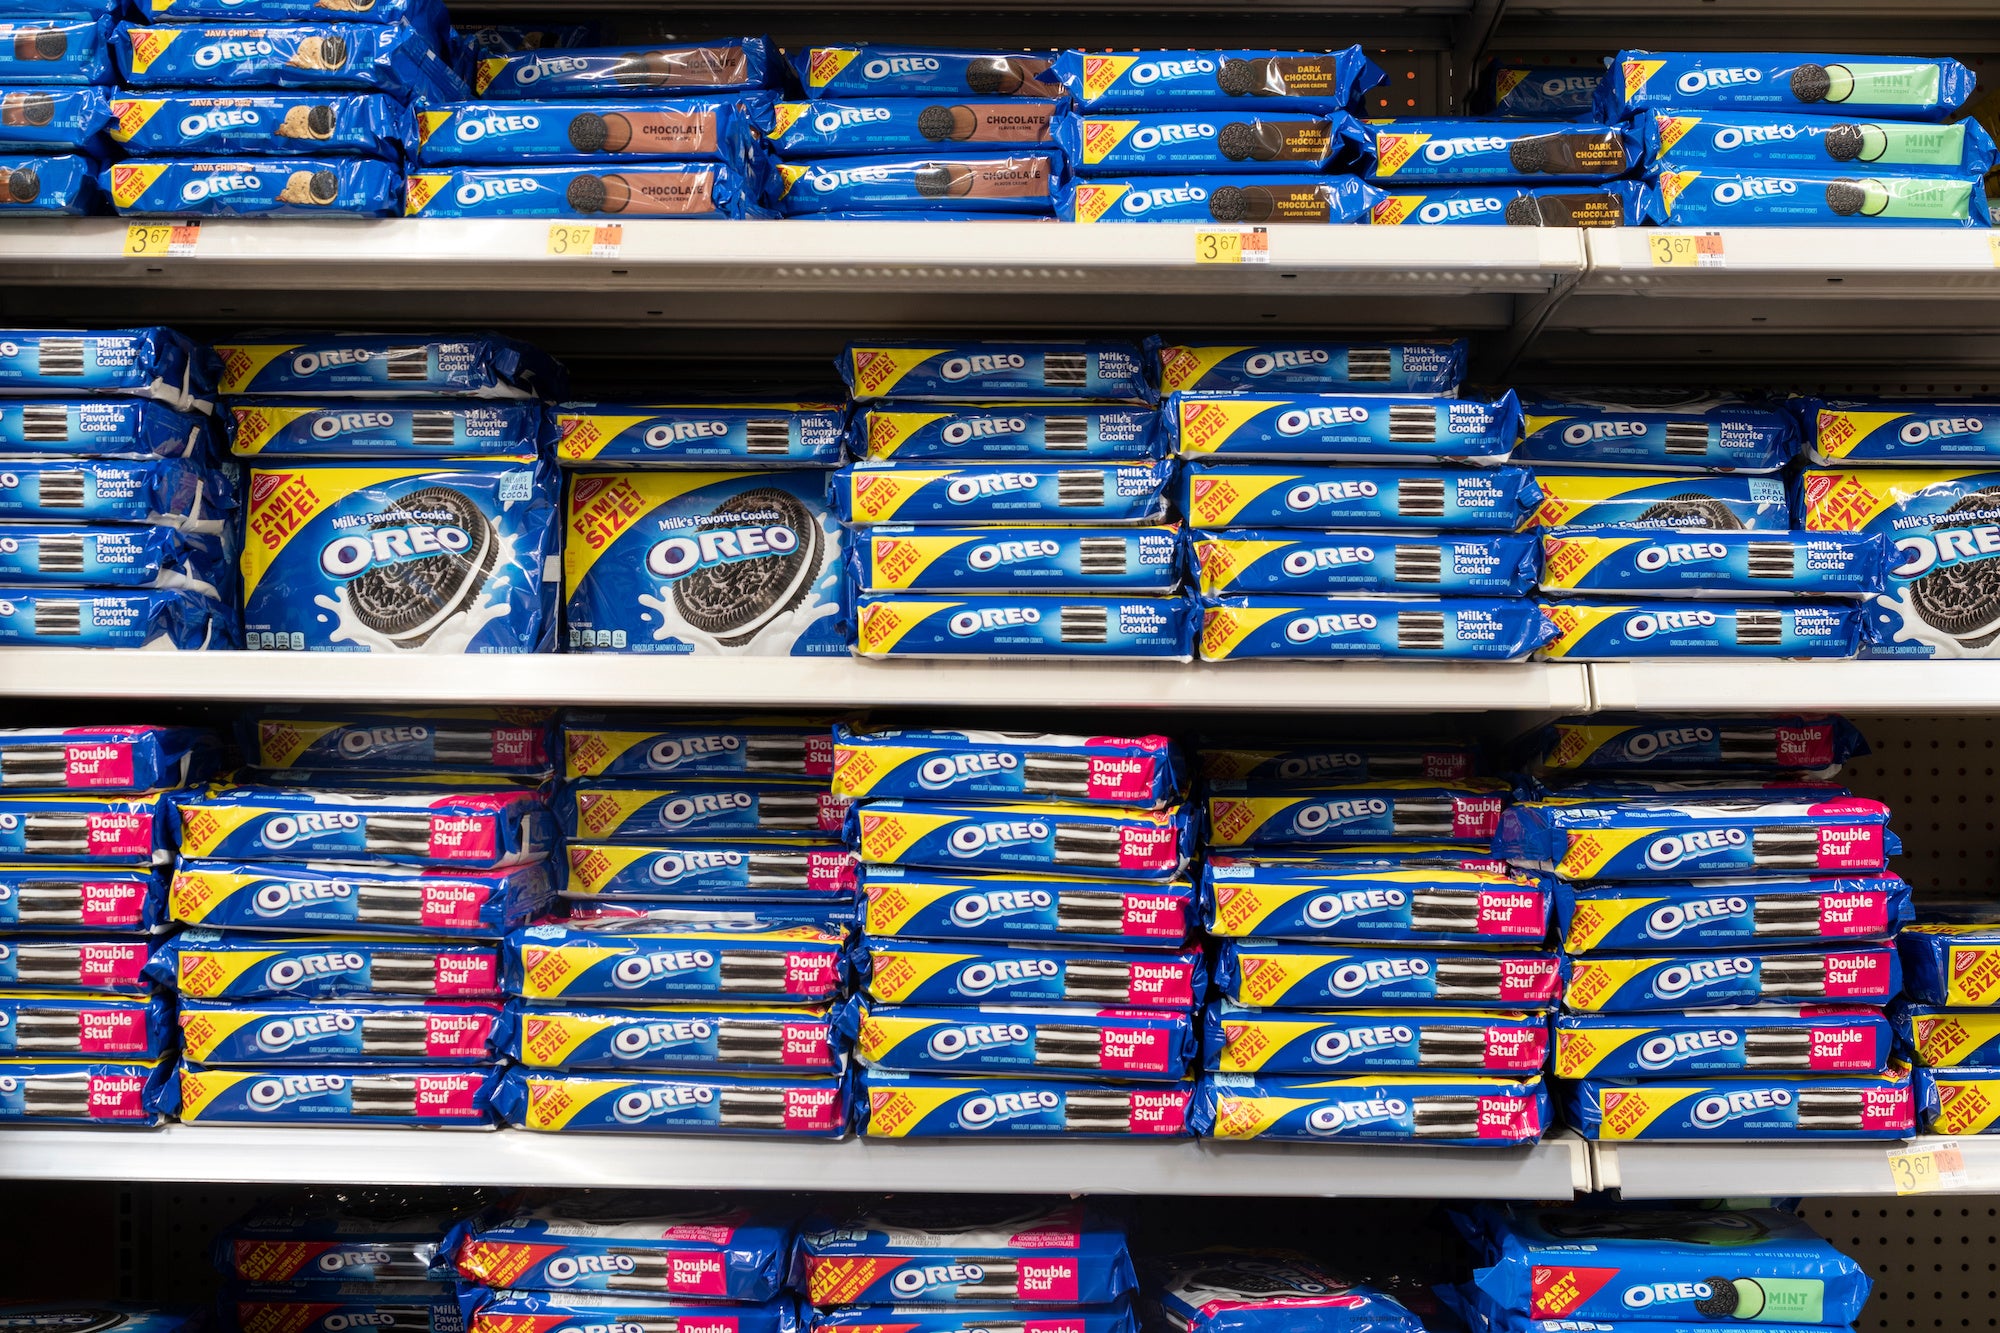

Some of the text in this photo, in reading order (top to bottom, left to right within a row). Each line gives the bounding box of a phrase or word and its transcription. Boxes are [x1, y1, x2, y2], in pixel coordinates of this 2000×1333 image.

[203, 29, 227, 38] JAVA
[227, 29, 248, 38] CHIP
[193, 41, 273, 68] OREO
[813, 54, 840, 82] FAMILY
[821, 63, 840, 82] SIZE
[862, 56, 940, 81] OREO
[1088, 61, 1116, 90] FAMILY
[1131, 59, 1214, 85] OREO
[1284, 73, 1332, 81] CHOCOLATE
[1297, 65, 1321, 73] DARK
[1677, 68, 1762, 94] OREO
[1872, 75, 1912, 87] MINT
[1097, 73, 1116, 91] SIZE
[179, 109, 260, 136] OREO
[456, 115, 540, 141] OREO
[642, 125, 705, 135] CHOCOLATE
[813, 107, 891, 133] OREO
[986, 115, 1045, 125] CHOCOLATE
[1131, 123, 1215, 150] OREO
[1299, 129, 1322, 138] DARK
[1587, 142, 1612, 151] DARK
[1713, 125, 1797, 151] OREO
[1904, 135, 1944, 147] MINT
[1381, 136, 1410, 167] FAMILY
[1392, 149, 1411, 167] SIZE
[1424, 137, 1507, 163] OREO
[1575, 150, 1622, 159] CHOCOLATE
[191, 164, 236, 172] JAVA CHIP
[117, 167, 146, 197] FAMILY
[127, 182, 146, 201] SIZE
[181, 175, 261, 202] OREO
[456, 177, 538, 205] OREO
[641, 186, 704, 196] CHOCOLATE
[1713, 180, 1797, 205] OREO
[1123, 186, 1207, 212] OREO
[1277, 200, 1326, 209] CHOCOLATE
[1290, 193, 1314, 201] DARK
[860, 351, 891, 384] FAMILY
[865, 359, 899, 393] SIZE!
[941, 354, 1025, 381] OREO
[80, 403, 113, 414] Milk's
[80, 412, 125, 423] Favorite
[465, 410, 497, 421] Milk's
[1187, 404, 1221, 438] FAMILY
[1277, 406, 1369, 435] OREO
[1448, 404, 1485, 415] Milk's
[1448, 413, 1494, 424] Favorite
[80, 422, 117, 432] Cookie
[311, 413, 394, 439] OREO
[465, 419, 508, 429] Favorite
[465, 428, 500, 438] Cookie
[645, 421, 728, 447] OREO
[1195, 412, 1229, 447] SIZE!
[1448, 423, 1486, 433] Cookie
[1900, 418, 1983, 445] OREO
[254, 475, 280, 501] NABISCO
[501, 491, 529, 499] COCOA
[575, 479, 601, 501] NABISCO
[249, 474, 309, 535] FAMILY
[572, 477, 633, 536] FAMILY
[262, 490, 320, 550] SIZE!
[332, 509, 454, 530] Milk's Favorite Cookie
[585, 492, 647, 550] SIZE!
[658, 510, 780, 531] Milk's Favorite Cookie
[322, 525, 469, 576] OREO
[648, 526, 797, 576] OREO
[880, 542, 913, 576] FAMILY
[969, 540, 1060, 569] OREO
[1636, 542, 1728, 571] OREO
[1806, 541, 1842, 551] Milk's
[1806, 550, 1854, 560] Favorite
[887, 550, 921, 583] SIZE!
[1806, 560, 1845, 570] Cookie
[949, 608, 1040, 636] OREO
[1286, 612, 1377, 642] OREO
[1457, 611, 1492, 621] Milk's
[1457, 620, 1503, 631] Favorite
[1457, 630, 1495, 640] Cookie
[68, 747, 118, 761] Double
[1093, 760, 1141, 774] Double
[69, 761, 100, 775] Stuf
[838, 750, 870, 785] FAMILY
[844, 759, 878, 793] SIZE!
[922, 753, 1018, 783] OREO
[1093, 773, 1123, 787] Stuf
[583, 794, 614, 826] FAMILY
[588, 802, 622, 835] SIZE!
[663, 792, 752, 821] OREO
[265, 813, 360, 842] OREO
[433, 818, 482, 833] Double
[952, 822, 1049, 853] OREO
[1822, 827, 1871, 841] Double
[433, 832, 463, 846] Stuf
[1649, 827, 1746, 862] OREO
[1822, 842, 1851, 855] Stuf
[1220, 889, 1255, 924] FAMILY
[1307, 889, 1406, 921] OREO
[1482, 894, 1533, 908] Double
[1227, 897, 1262, 932] SIZE!
[1482, 908, 1513, 921] Stuf
[185, 957, 218, 991] FAMILY
[269, 953, 364, 982] OREO
[615, 950, 714, 984] OREO
[962, 958, 1058, 989] OREO
[1657, 957, 1754, 993] OREO
[1828, 956, 1877, 970] Double
[191, 965, 226, 997] SIZE!
[1571, 964, 1604, 999] FAMILY
[1577, 972, 1612, 1008] SIZE!
[1828, 970, 1858, 984] Stuf
[1315, 1025, 1414, 1055] OREO
[1922, 1017, 1961, 1060] FAMILY
[1927, 1027, 1970, 1067] SIZE!
[962, 1090, 1058, 1120] OREO
[1134, 1095, 1183, 1108] Double
[1134, 1107, 1164, 1121] Stuf
[1695, 1089, 1793, 1123] OREO
[548, 1255, 635, 1281] OREO
[672, 1259, 721, 1272] Double
[672, 1272, 701, 1284] Stuf
[894, 1265, 983, 1291] OREO
[1024, 1266, 1071, 1279] Double
[1024, 1278, 1052, 1290] Stuf
[1535, 1271, 1576, 1310] PARTY
[1624, 1283, 1712, 1308] OREO
[1550, 1286, 1580, 1314] SIZE
[1768, 1291, 1807, 1305] MINT
